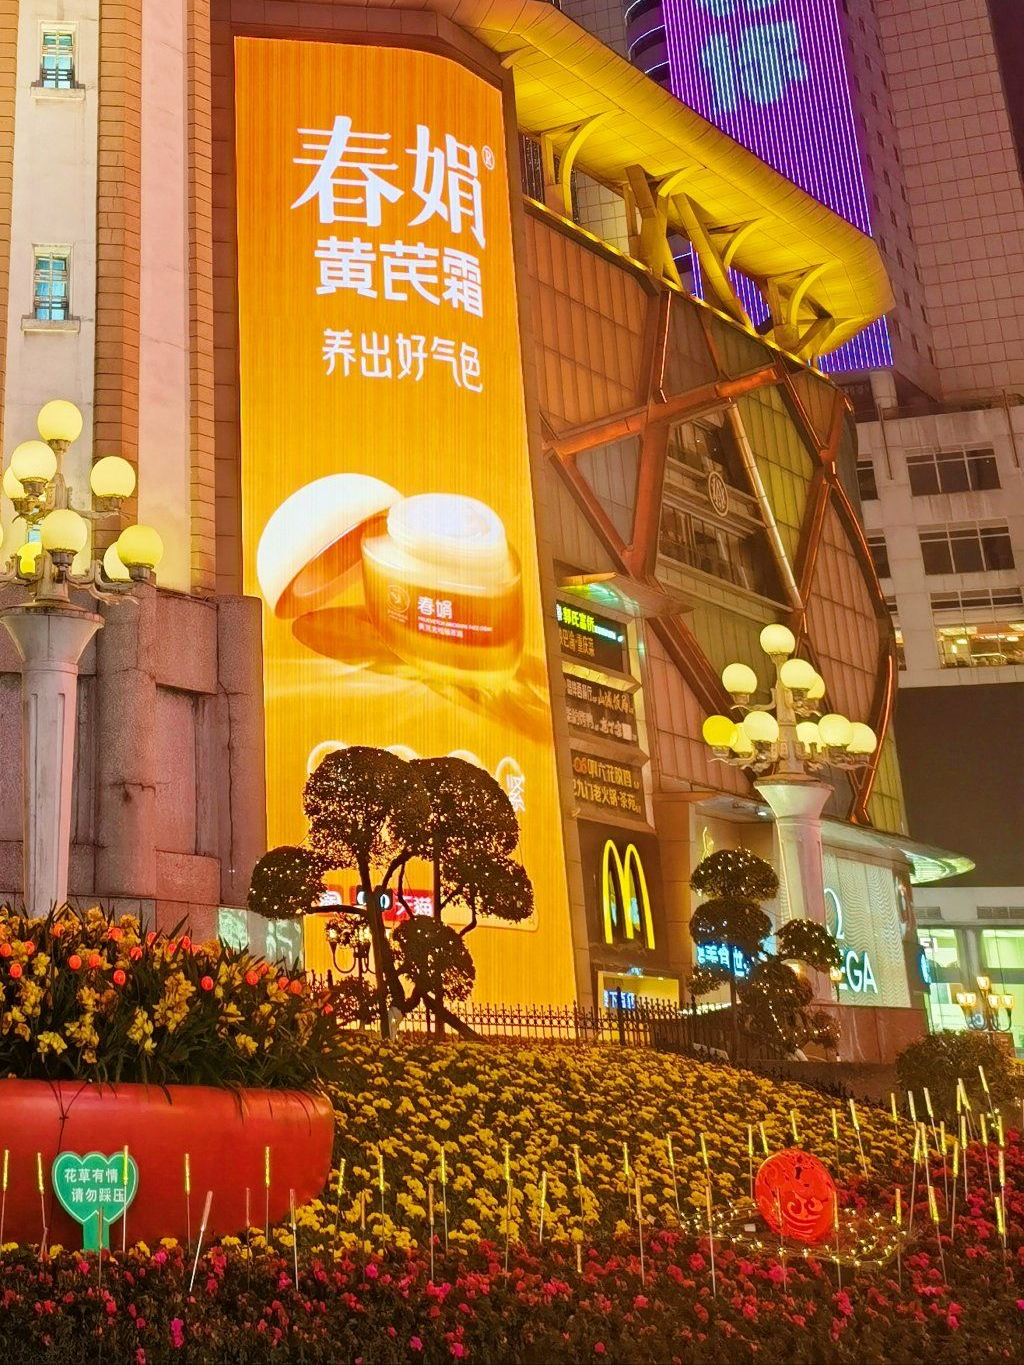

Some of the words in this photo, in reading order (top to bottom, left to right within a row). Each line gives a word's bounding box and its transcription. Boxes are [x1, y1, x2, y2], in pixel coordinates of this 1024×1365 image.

[290, 114, 487, 249] 春娟
[314, 236, 484, 318] 黄芪霜
[321, 328, 484, 393] 养出好气色
[64, 1168, 118, 1183] 花草有情
[72, 1187, 125, 1203] 请勿踩压
